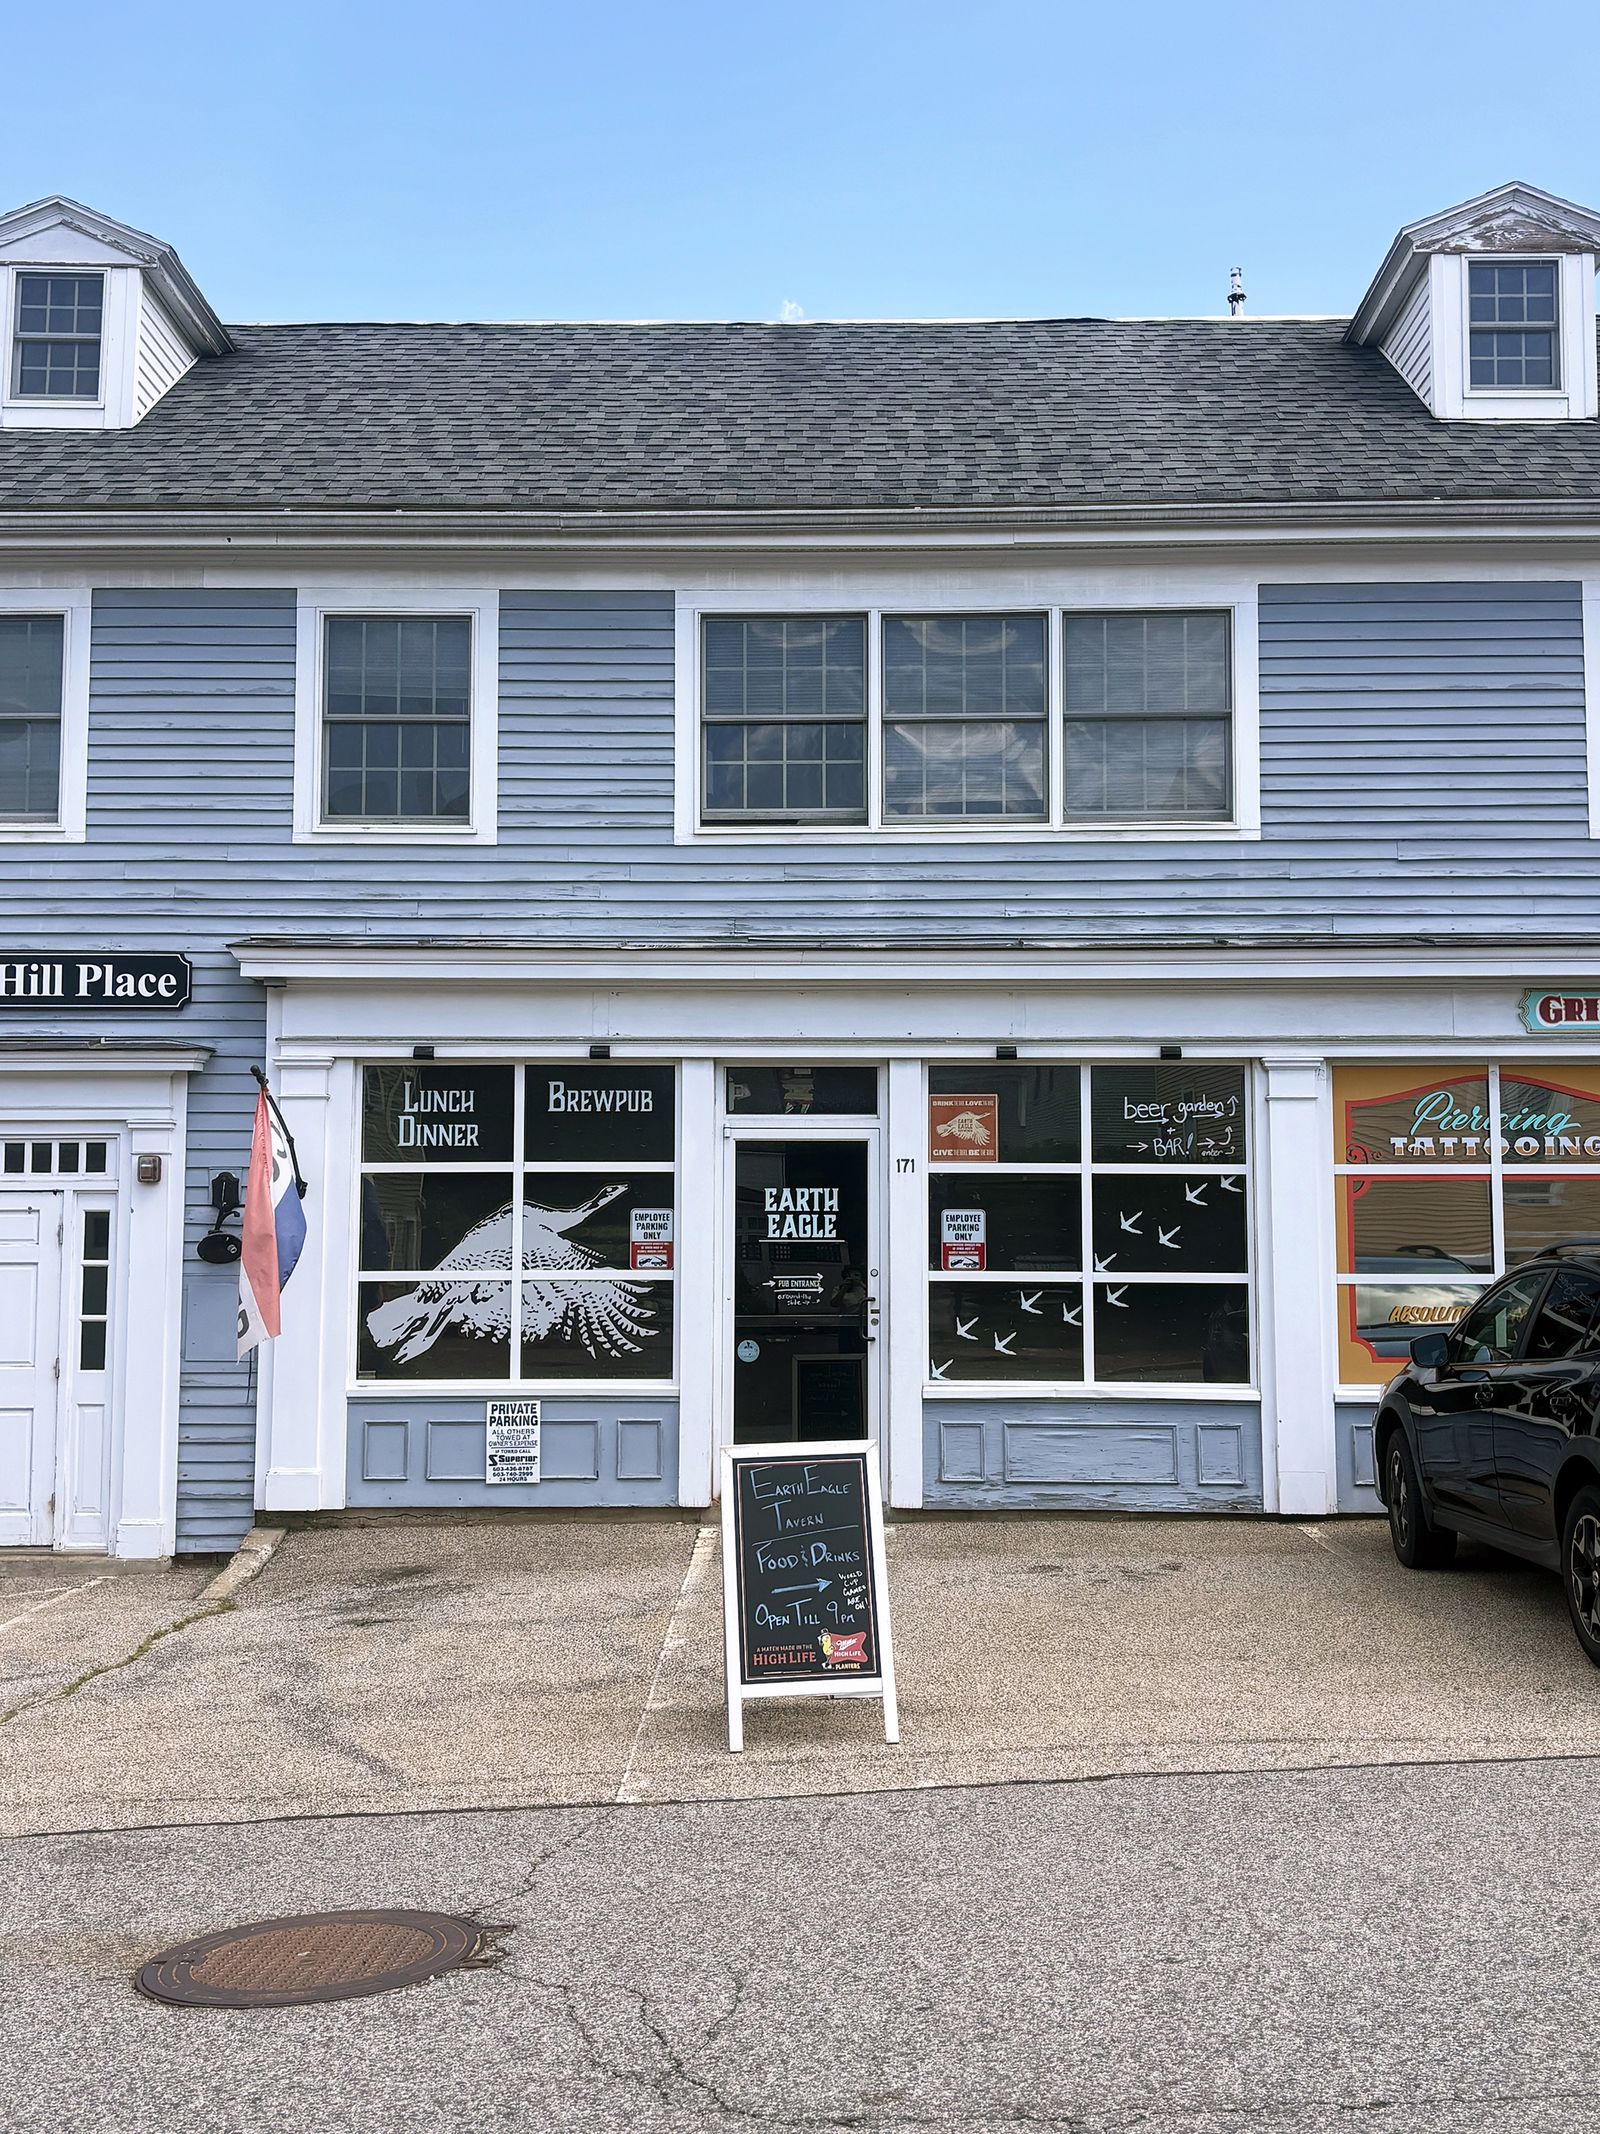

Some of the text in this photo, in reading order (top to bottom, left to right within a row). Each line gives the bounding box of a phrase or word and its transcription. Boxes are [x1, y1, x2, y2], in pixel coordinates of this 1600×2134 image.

[0, 963, 177, 998] Hill Place
[403, 1081, 475, 1112] LUNCH
[547, 1081, 653, 1112] BREWPUB
[1124, 1094, 1225, 1123] beer garden
[397, 1115, 480, 1146] DINNER
[1153, 1132, 1194, 1157] BAR!
[1201, 1149, 1223, 1157] enter
[1390, 1137, 1600, 1156] TATTOOING
[896, 1158, 915, 1173] 171
[764, 1188, 839, 1211] EARTH
[634, 1213, 670, 1221] EMPLOYEE
[767, 1214, 837, 1238] EAGLE
[945, 1214, 981, 1222] EMPLOYEE
[636, 1222, 669, 1231] PARKING
[643, 1231, 661, 1240] ONLY
[947, 1223, 980, 1232] PARKING
[954, 1232, 972, 1241] ONLY
[778, 1280, 790, 1288] PUB
[1388, 1305, 1471, 1323] ABSOLUT
[491, 1403, 537, 1414] PRIVATE
[489, 1415, 538, 1427] PARKING
[750, 1464, 852, 1499] EARTH EAGLE
[761, 1499, 824, 1531] TAVERN
[757, 1541, 799, 1573] FOOD
[811, 1542, 860, 1566] DRINKS
[844, 1578, 859, 1587] CUP
[755, 1604, 789, 1630] OPEN
[786, 1598, 820, 1626] TILL
[826, 1601, 839, 1624] 9
[753, 1652, 817, 1666] HIGH LIFE
